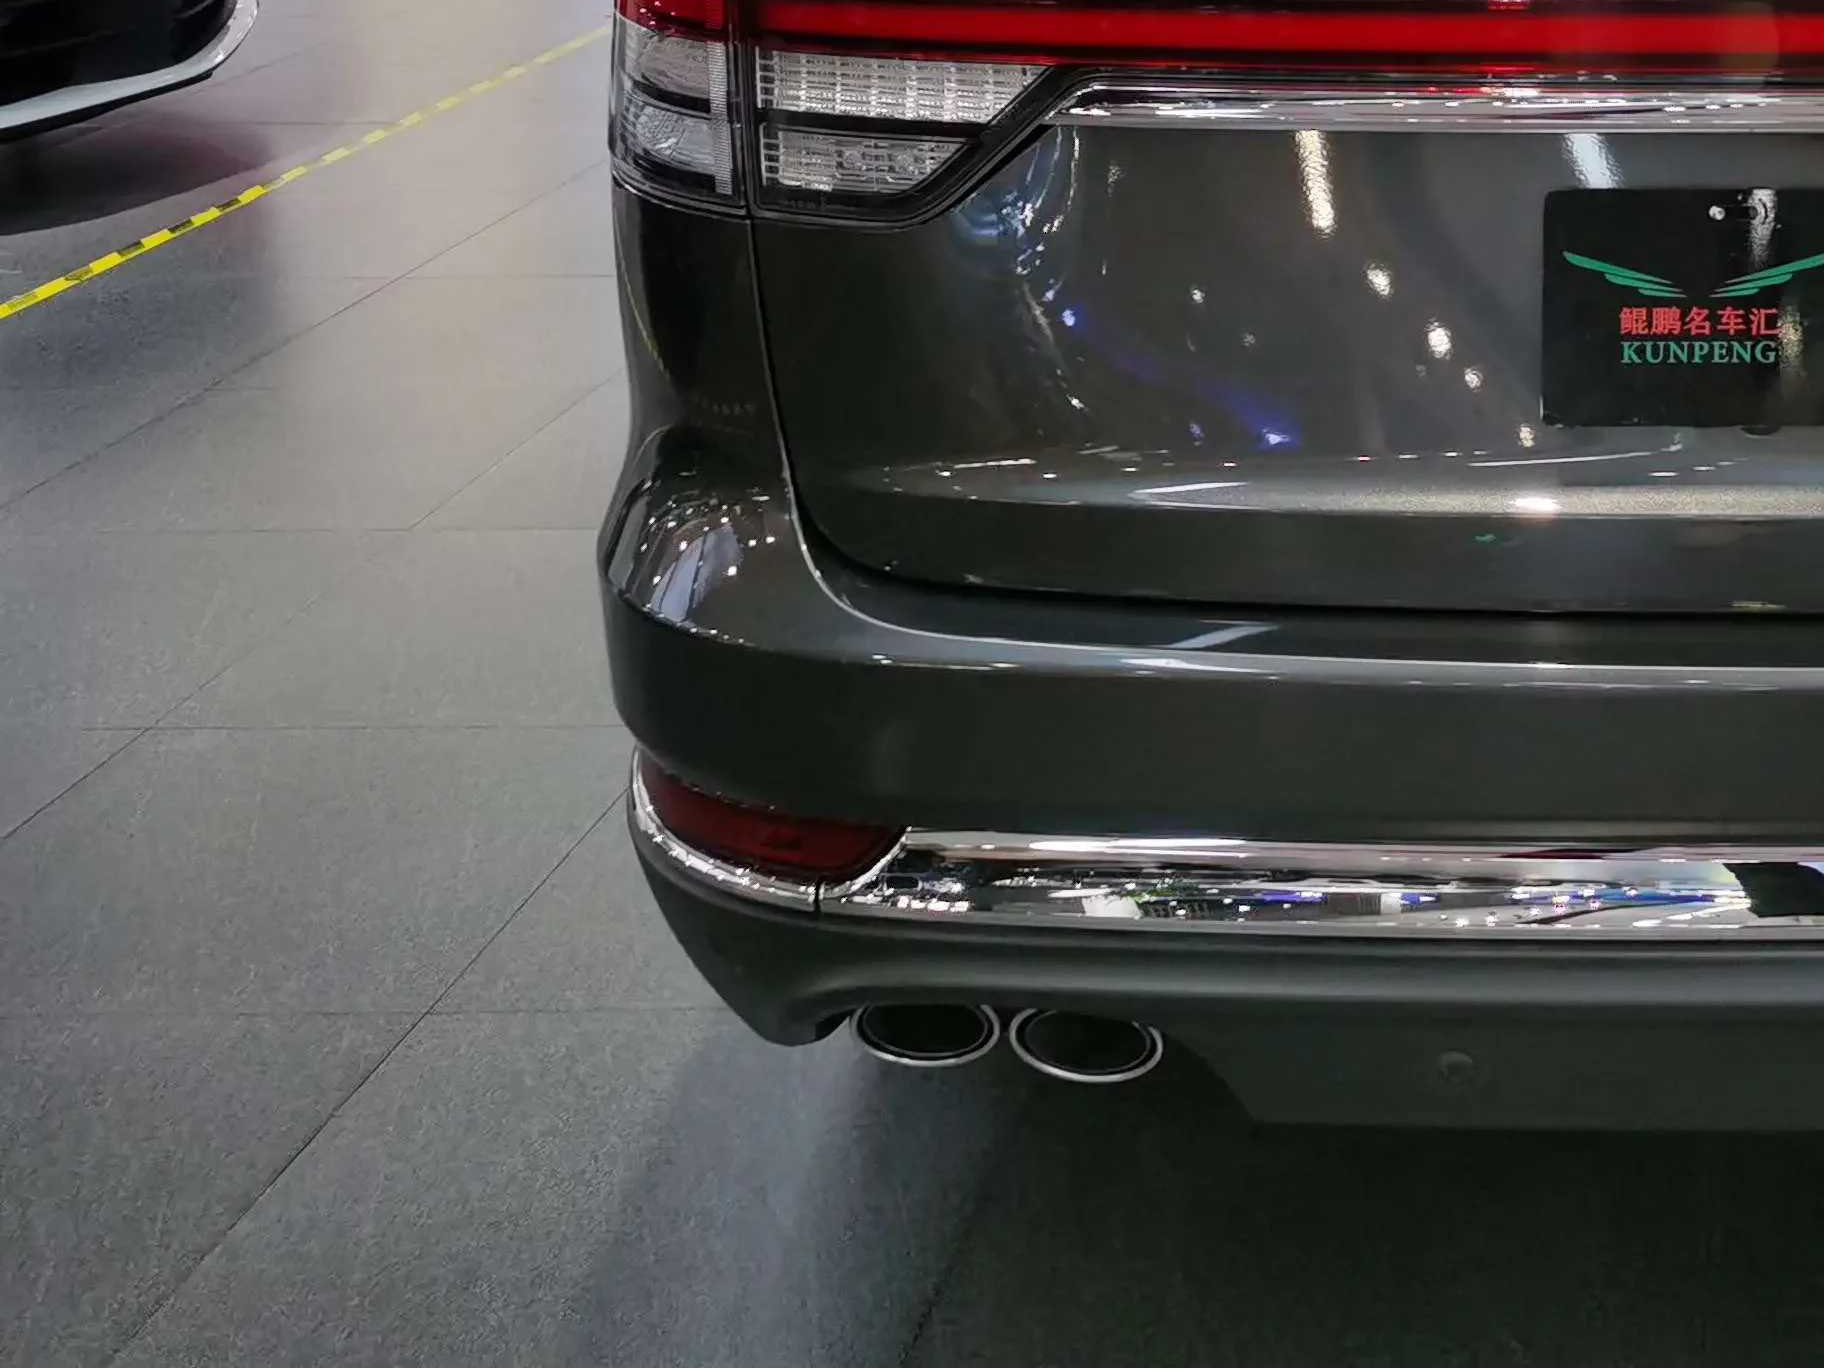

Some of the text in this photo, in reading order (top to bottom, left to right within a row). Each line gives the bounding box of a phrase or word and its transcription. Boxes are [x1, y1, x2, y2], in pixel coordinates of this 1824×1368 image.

[1619, 306, 1781, 335] 鲲鹏名车汇
[1620, 340, 1778, 364] KUNPENG
